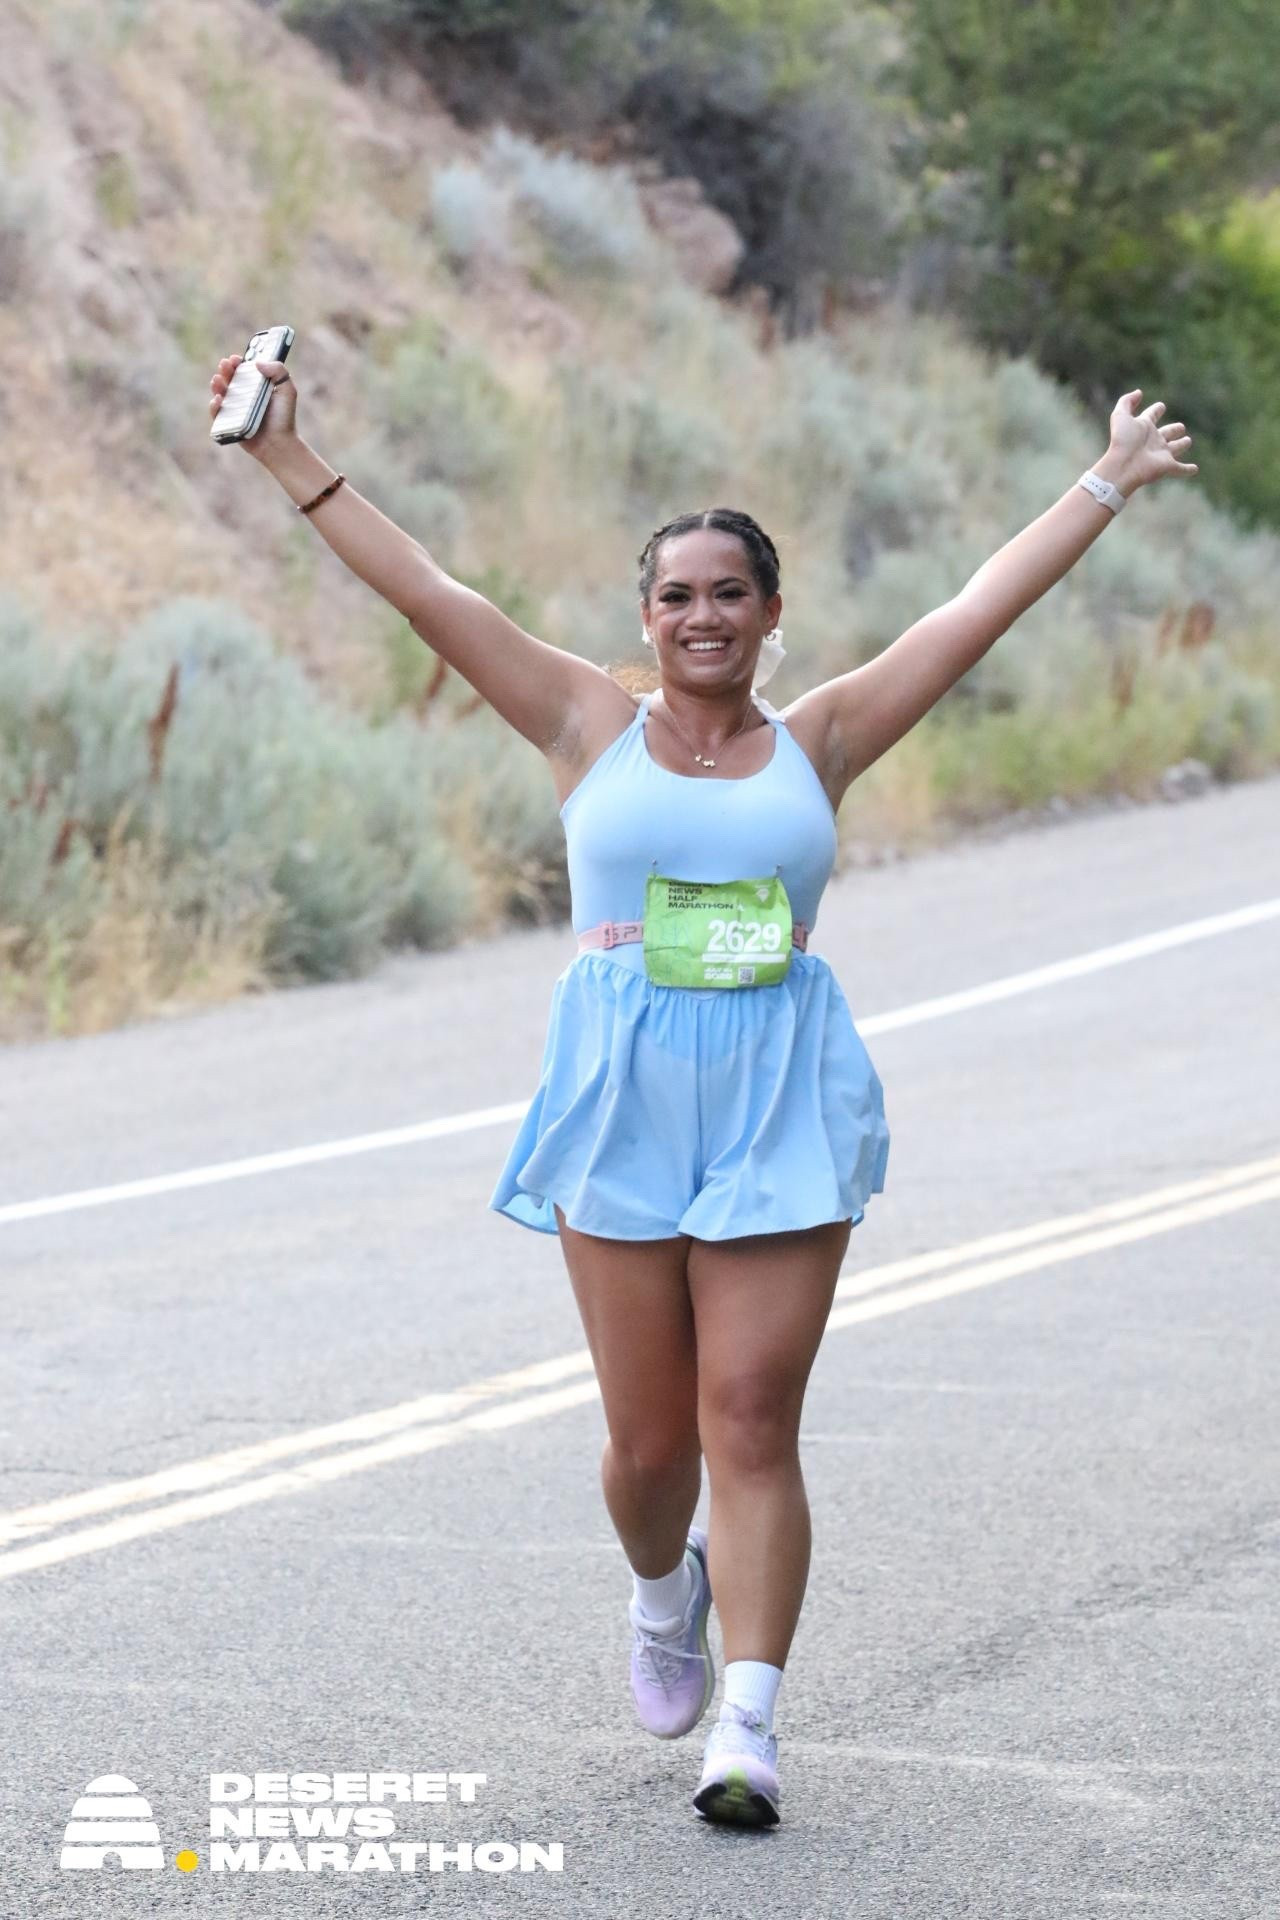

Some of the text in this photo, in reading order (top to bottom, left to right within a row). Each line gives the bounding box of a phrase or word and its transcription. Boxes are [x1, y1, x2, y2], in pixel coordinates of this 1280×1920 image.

[668, 887, 703, 895] NEWS
[668, 902, 734, 910] MARATHON
[707, 919, 781, 952] 2629
